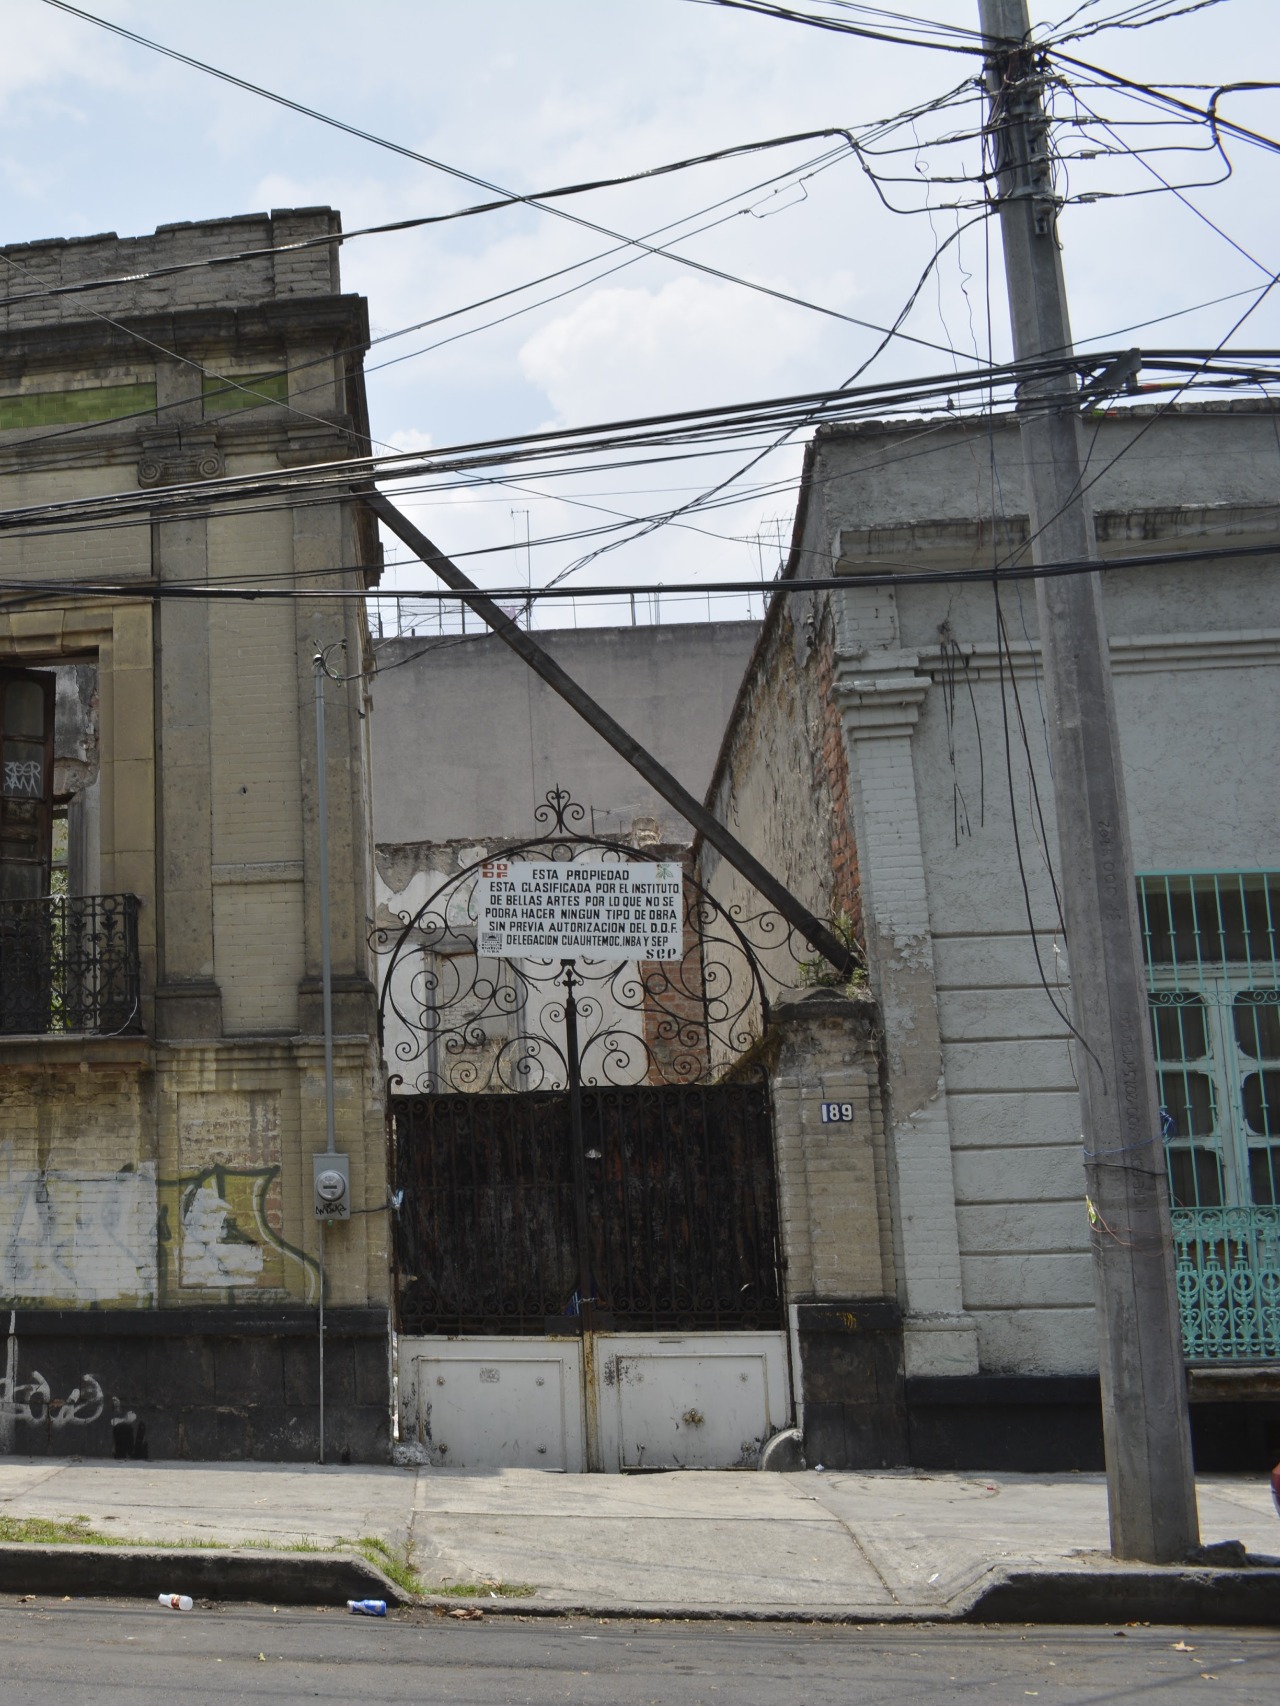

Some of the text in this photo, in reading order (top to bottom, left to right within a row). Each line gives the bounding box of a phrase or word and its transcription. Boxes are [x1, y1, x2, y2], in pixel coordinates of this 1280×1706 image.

[532, 869, 630, 881] ESTA PROPIEDAD
[489, 881, 680, 894] ESTA CLASIFICADA POR EL INSTITUTO
[490, 894, 674, 908] DE BELLAS ARTES POR LO QUE NO SE
[485, 907, 677, 920] PODRA HACER NINGUN TIPO DE OBRA
[489, 921, 678, 934] SIN PREVIA AUTORIZACION DEL D.D.F.
[506, 934, 559, 945] DELEGACION
[643, 936, 650, 947] Y
[651, 936, 669, 947] SEP
[821, 1104, 853, 1122] 189
